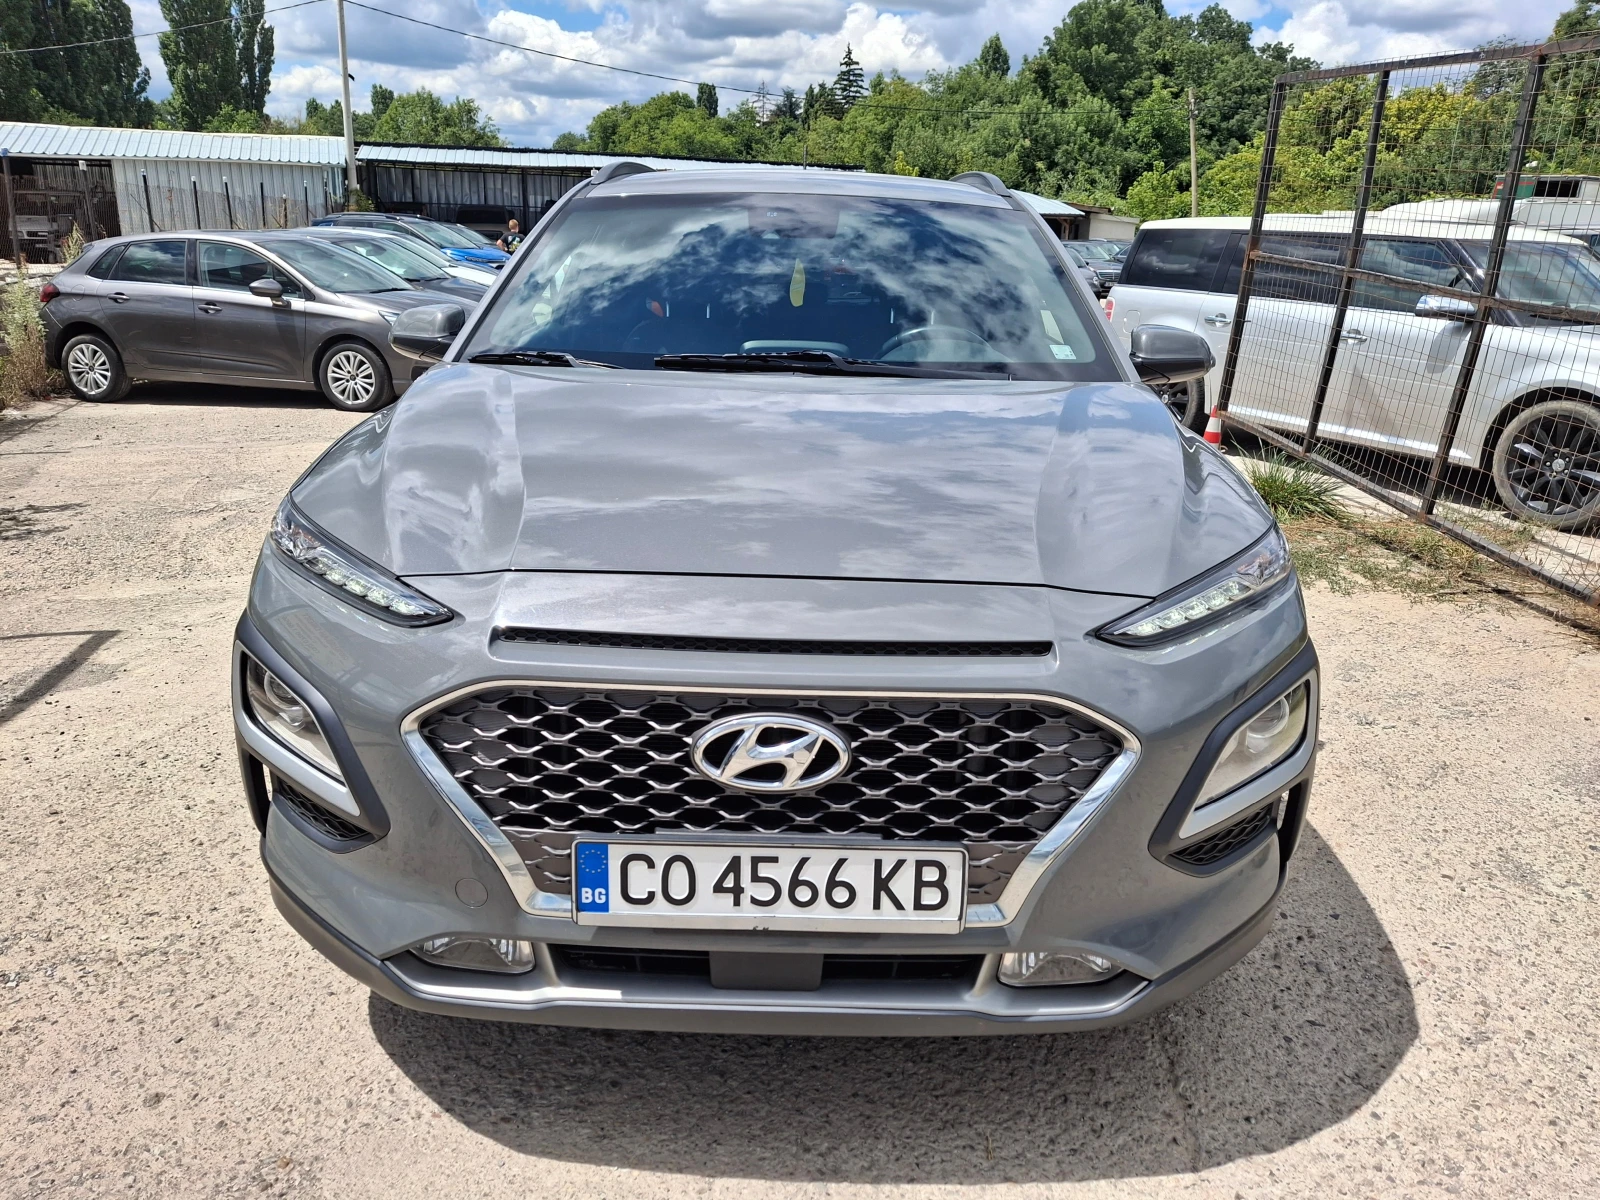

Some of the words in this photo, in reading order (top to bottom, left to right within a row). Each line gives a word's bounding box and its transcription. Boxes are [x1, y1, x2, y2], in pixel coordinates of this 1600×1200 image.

[581, 887, 607, 905] BG
[619, 853, 696, 906] CO
[712, 855, 857, 909] 4566
[872, 858, 950, 911] KB
